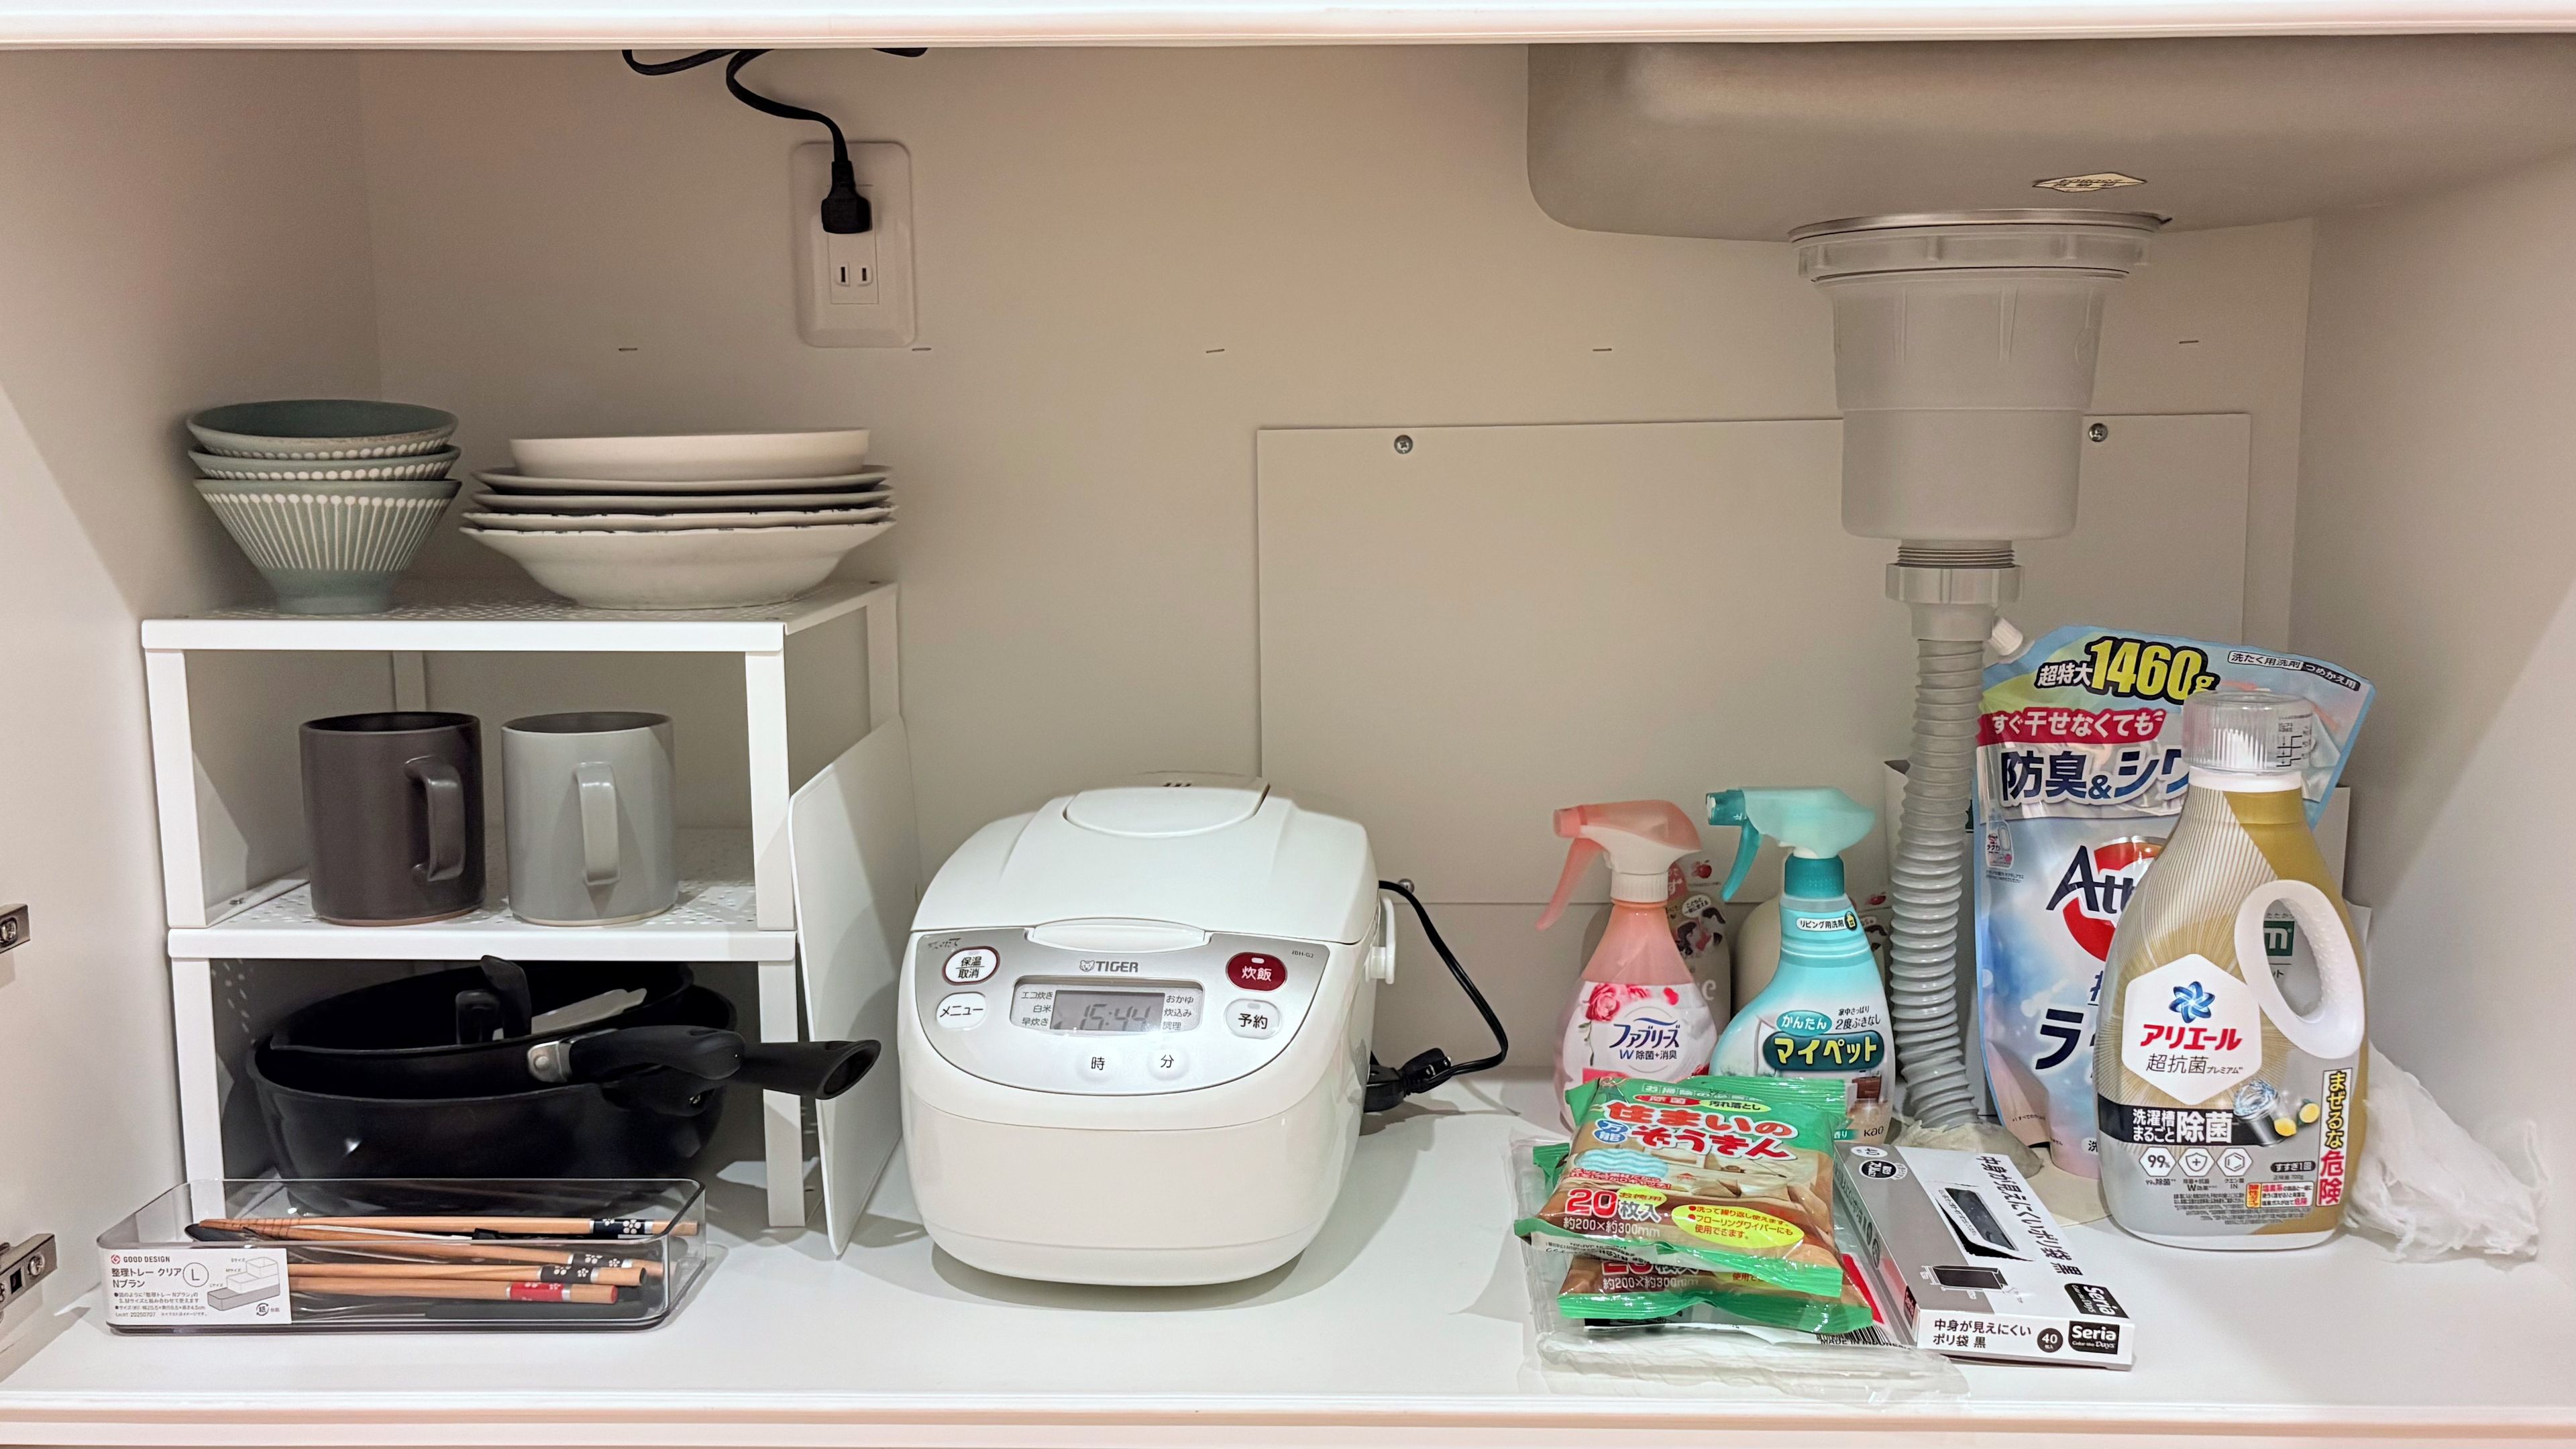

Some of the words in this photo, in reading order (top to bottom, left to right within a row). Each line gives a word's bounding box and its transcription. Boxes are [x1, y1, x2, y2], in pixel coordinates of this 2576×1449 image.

[2037, 661, 2092, 687] 超特大
[2306, 663, 2357, 689] つめかえ用
[1992, 711, 2154, 738] すぐ干せなくても
[1800, 920, 1844, 929] リビング用洗剤
[961, 956, 982, 967] 保温
[1096, 961, 1138, 973] TIGER
[958, 969, 979, 979] 取消
[1241, 966, 1273, 981] 炊飯
[1022, 991, 1053, 1000] エコ炊き
[1166, 995, 1194, 1004] おかゆ
[940, 1006, 983, 1018] メニュー
[1033, 1005, 1051, 1013] 白米
[1164, 1008, 1192, 1018] 炊込み
[1022, 1018, 1049, 1026] 早炊き
[1163, 1021, 1181, 1031] 調理
[1238, 1013, 1268, 1029] 予約
[1781, 1014, 1827, 1030] かんたん
[1609, 1024, 1680, 1049] ファブリーズ
[2140, 1024, 2243, 1051] アリエール
[1619, 1049, 1634, 1059] W
[1774, 1036, 1877, 1065] マイペット
[1091, 1057, 1106, 1071] 時
[1161, 1055, 1174, 1068] 分
[2146, 1053, 2209, 1074] 超抗菌
[1709, 1101, 1761, 1111] 汚れ落とし
[1607, 1102, 1792, 1136] 住まいの
[2133, 1109, 2175, 1127] 洗濯槽
[2133, 1127, 2175, 1142] まるごと
[2176, 1112, 2233, 1144] 除菌
[1631, 1126, 1790, 1158] ぞうきん
[2320, 1071, 2347, 1205] まぜるな危険
[1566, 1189, 1617, 1218] 20
[1619, 1201, 1662, 1223] 枚入
[1976, 1155, 2072, 1261] 中身が見えにくいポリ袋
[2050, 1261, 2084, 1276] 黒
[1695, 1224, 1749, 1240] 使用できます。
[1696, 1215, 1793, 1236] フローリングワイパーにも
[112, 1268, 154, 1277] 整理トレー
[158, 1268, 182, 1277] クリア
[191, 1269, 201, 1281] L
[2083, 1285, 2116, 1316] Seria
[1934, 1318, 2031, 1336] 中身が見えにくい
[2072, 1324, 2116, 1340] Seria
[1932, 1334, 1968, 1347] ポリ袋
[1974, 1336, 1986, 1348] 黒
[2042, 1332, 2058, 1344] 40
